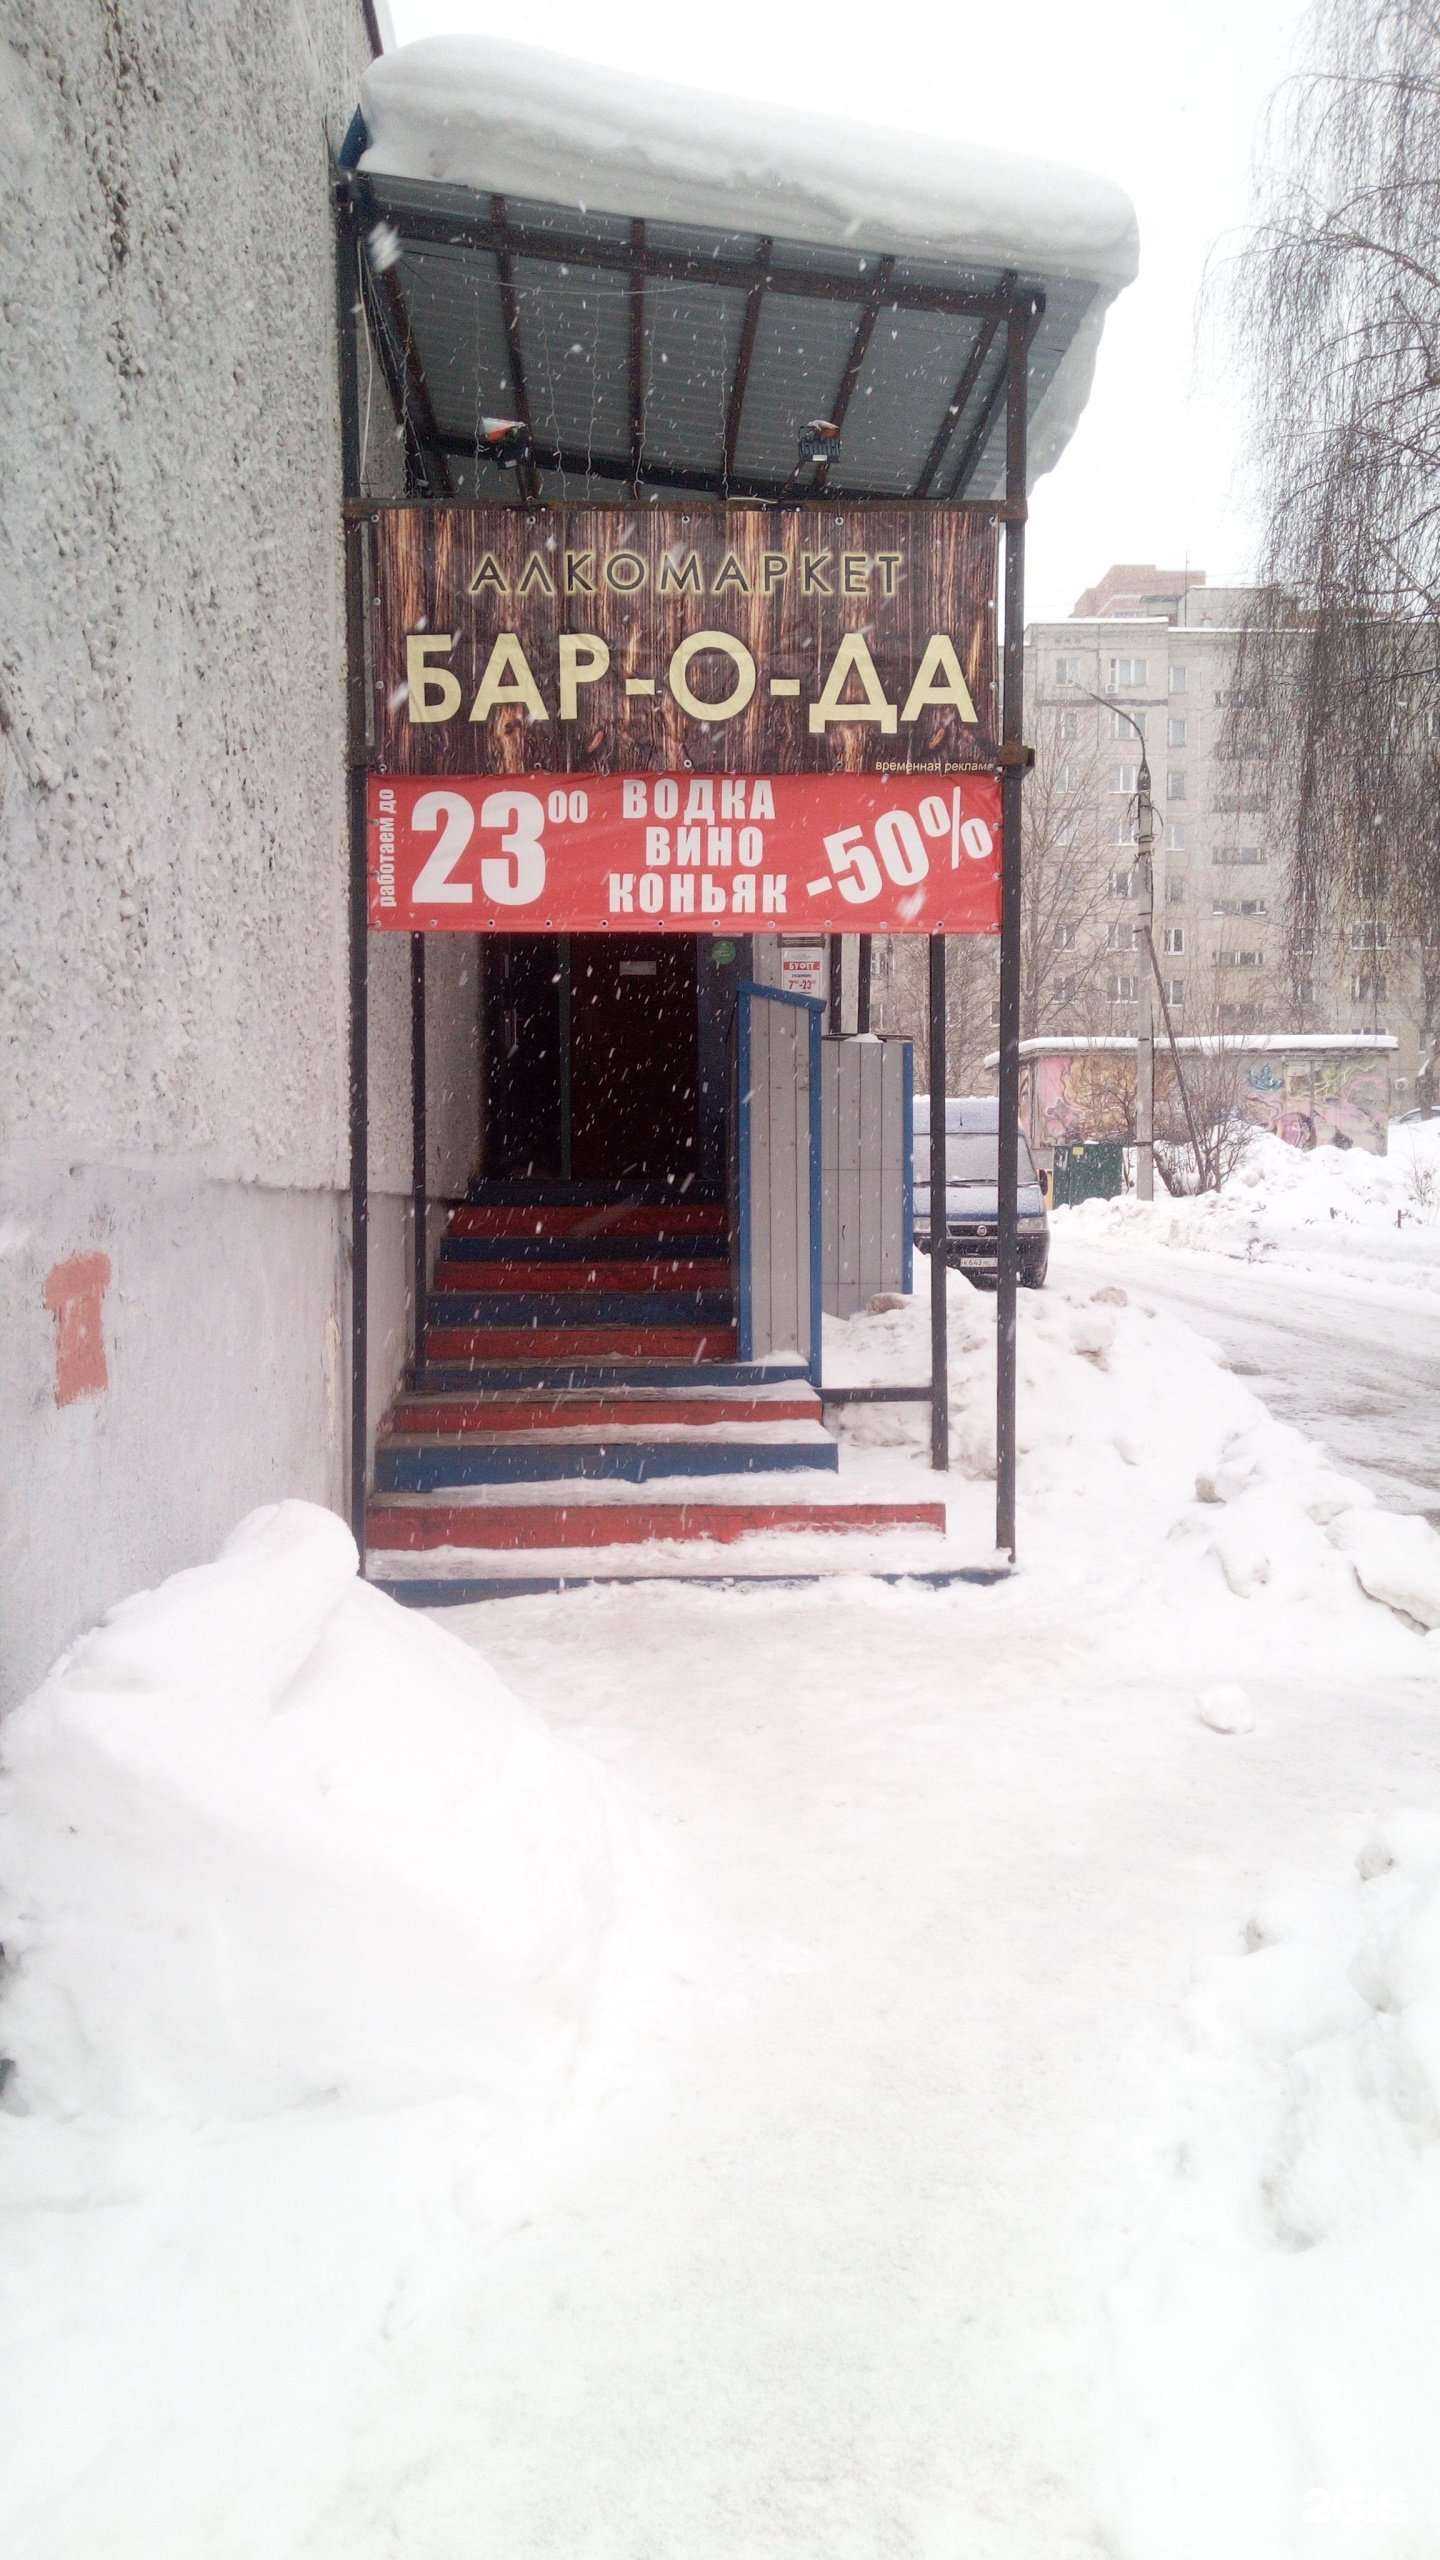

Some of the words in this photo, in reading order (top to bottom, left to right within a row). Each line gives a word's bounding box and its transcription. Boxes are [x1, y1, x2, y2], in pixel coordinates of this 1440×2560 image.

[471, 552, 901, 594] АЛКОМАРКЕТ
[406, 630, 978, 734] БАР-О-ДА
[875, 761, 941, 773] временная
[378, 788, 397, 814] до
[622, 778, 777, 826] ВОДКА
[376, 816, 397, 908] работаем
[645, 826, 764, 868] ВИНО
[805, 786, 994, 905] -50%
[608, 872, 788, 914] КОНЬЯК
